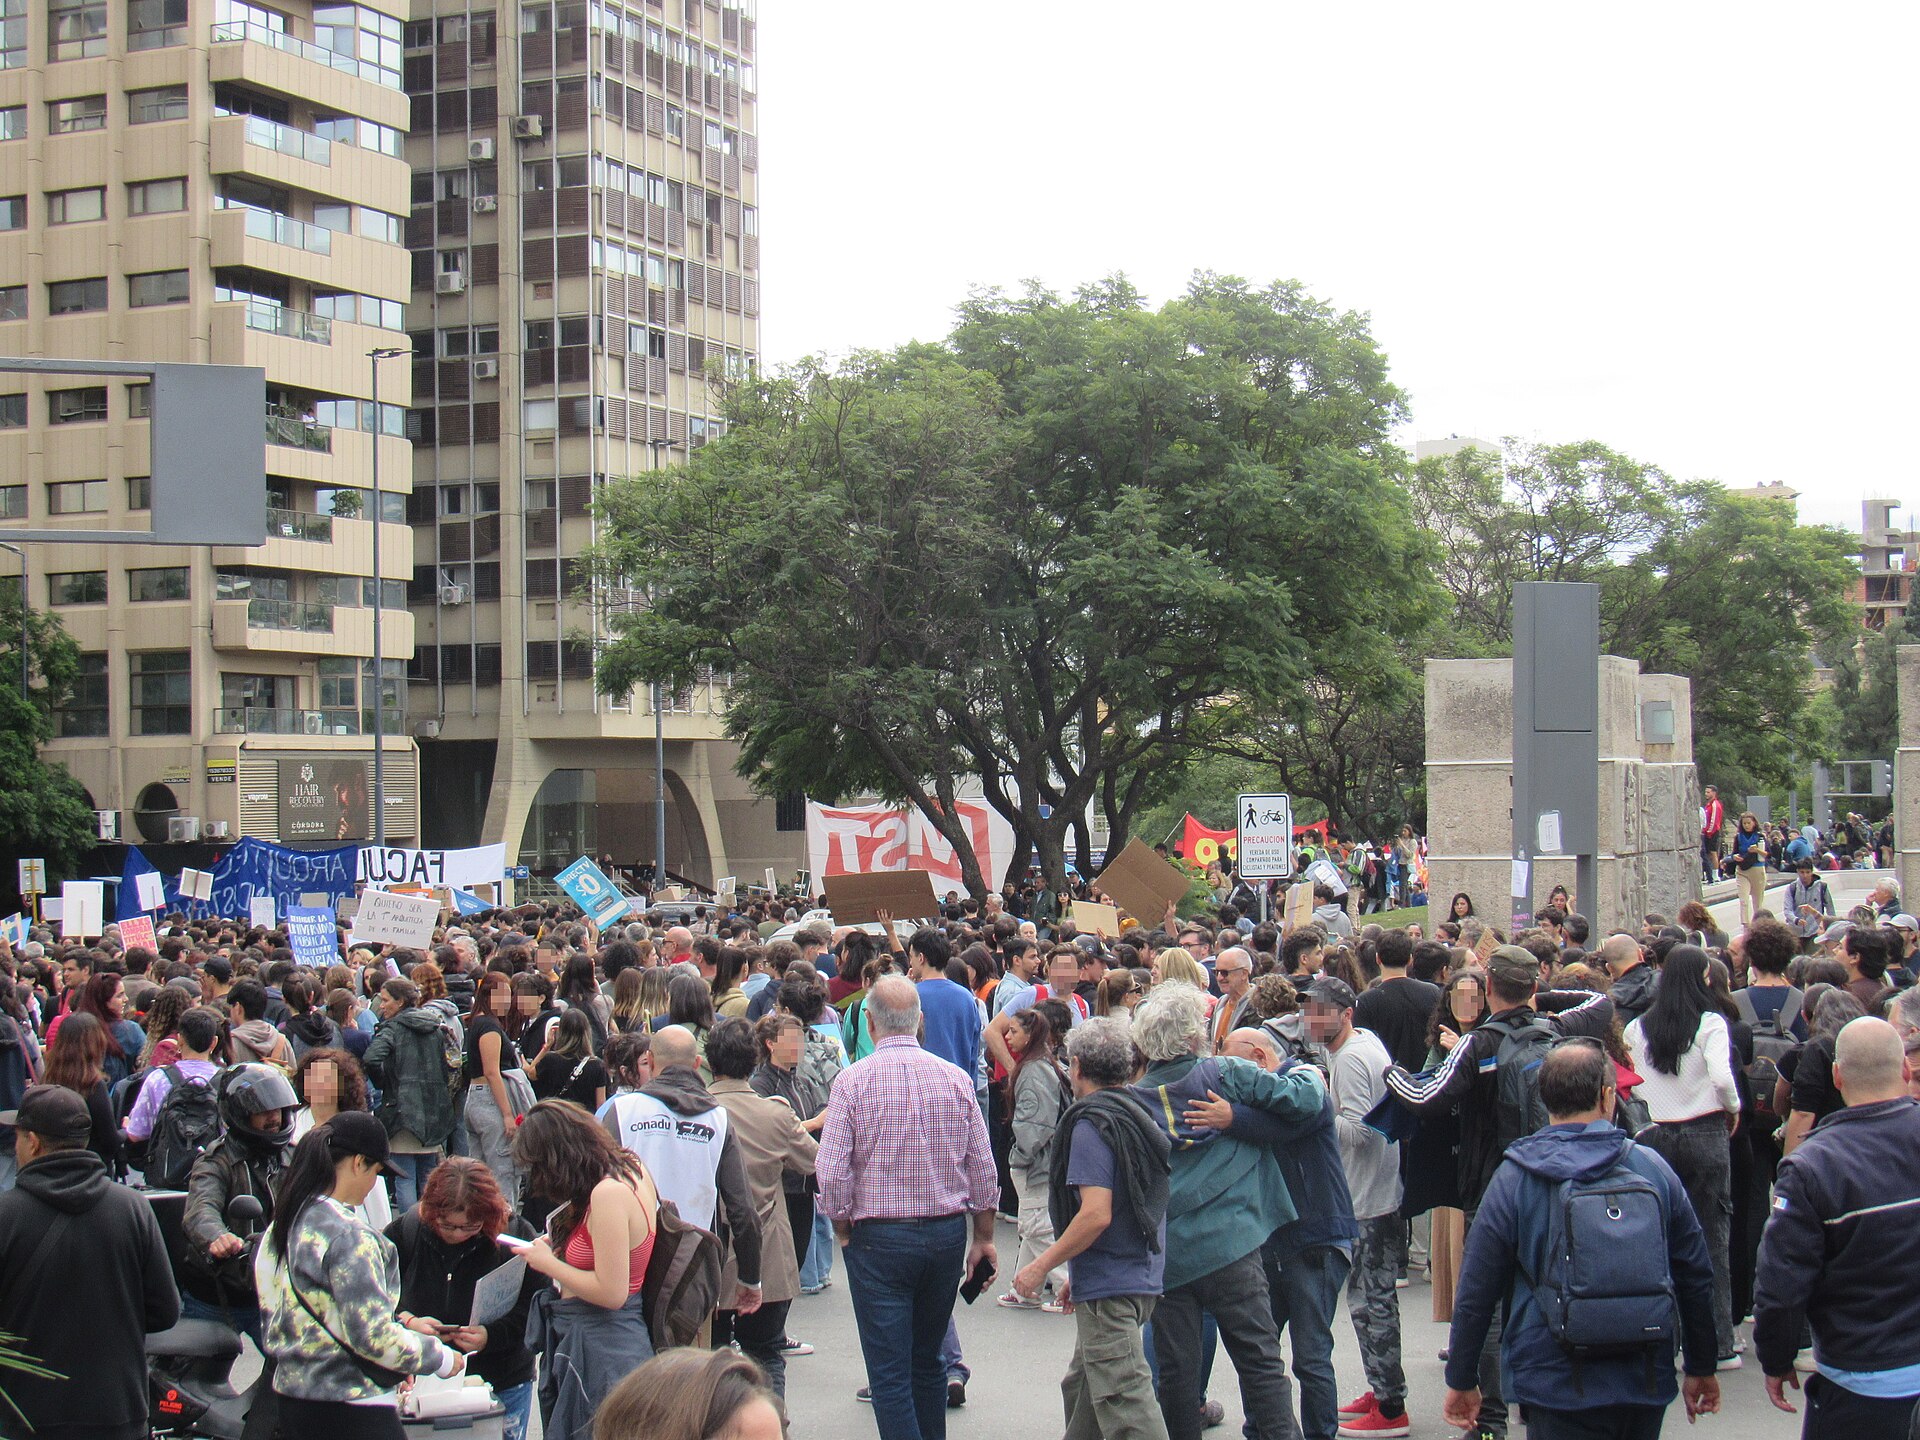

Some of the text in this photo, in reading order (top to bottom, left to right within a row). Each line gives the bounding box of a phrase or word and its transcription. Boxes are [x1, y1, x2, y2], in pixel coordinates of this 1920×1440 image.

[295, 783, 320, 796] HAIR
[289, 795, 325, 805] RECOVERY
[1243, 835, 1285, 844] PRECAUCION
[373, 897, 422, 913] QUIERO SER
[366, 910, 376, 920] LA
[630, 1118, 671, 1132] conadu
